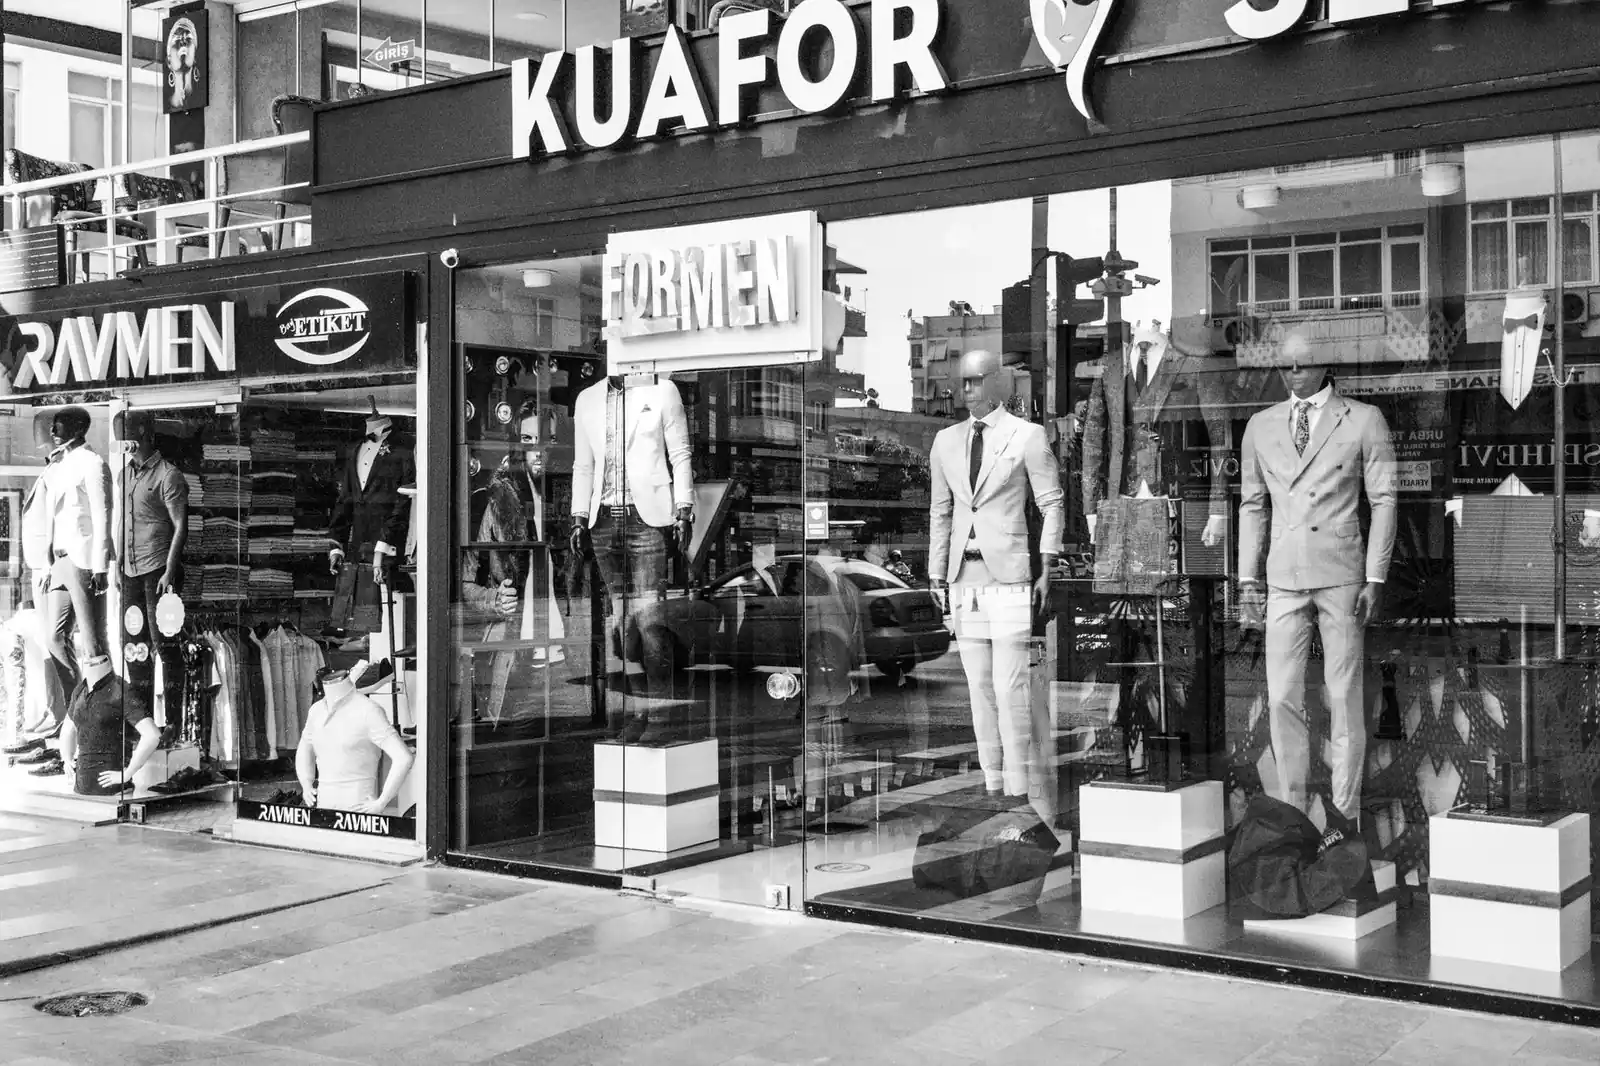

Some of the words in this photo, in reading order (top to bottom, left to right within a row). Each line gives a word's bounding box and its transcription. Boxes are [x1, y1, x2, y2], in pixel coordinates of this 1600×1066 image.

[294, 310, 366, 336] ETİKET
[13, 301, 236, 388] RAVMEN
[258, 804, 310, 826] RAVMEN
[333, 812, 389, 835] RAVMEN
